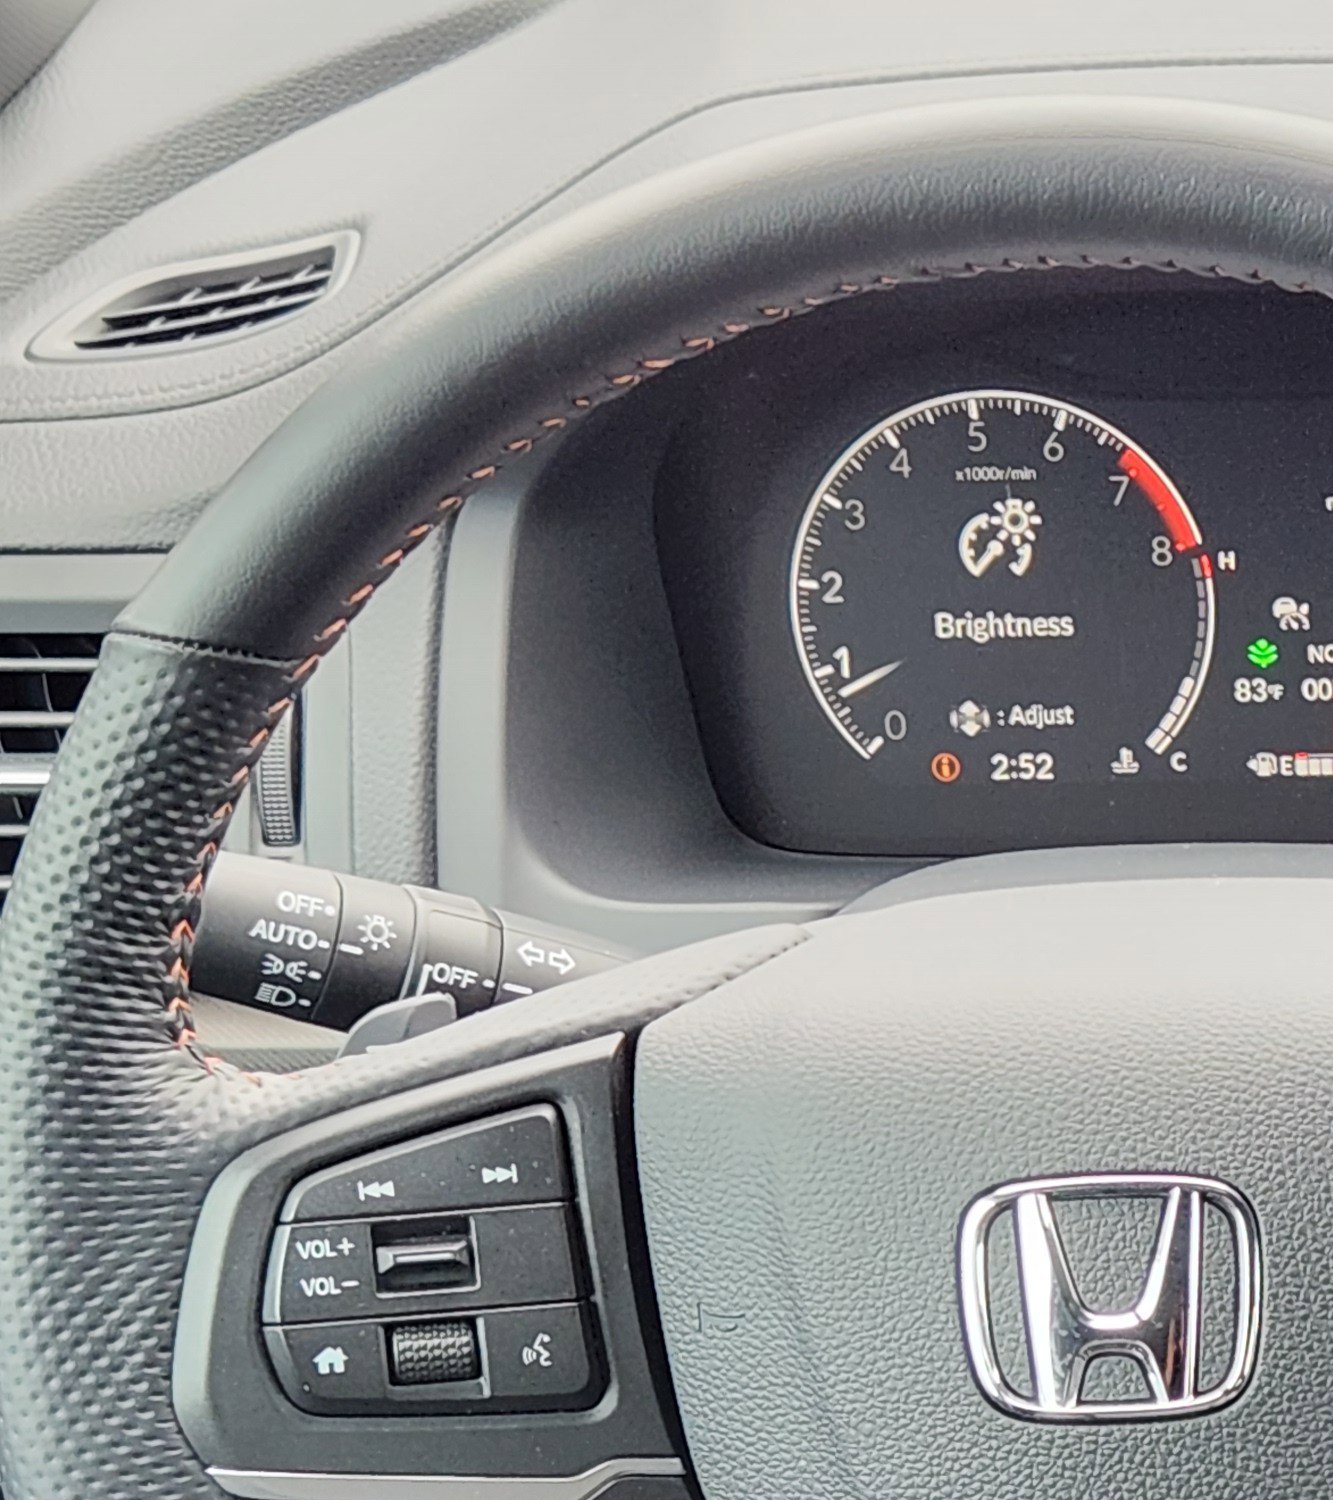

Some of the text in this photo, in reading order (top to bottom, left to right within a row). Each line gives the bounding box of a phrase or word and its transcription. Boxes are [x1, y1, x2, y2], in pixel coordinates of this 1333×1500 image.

[968, 421, 988, 452] 5
[1043, 432, 1065, 462] 6
[889, 448, 912, 479] 4
[1109, 475, 1131, 506] 7
[844, 499, 867, 530] 3
[1151, 536, 1173, 567] 8
[1218, 551, 1237, 571] H
[820, 571, 845, 604] 2
[934, 611, 1075, 645] Brightness
[833, 646, 851, 678] 1
[884, 710, 907, 740] 0
[990, 753, 1056, 781] 2:52
[1170, 752, 1189, 773] C
[1279, 755, 1295, 777] E
[276, 890, 323, 917] OFF
[248, 919, 319, 951] AUTO
[433, 961, 477, 989] OFF
